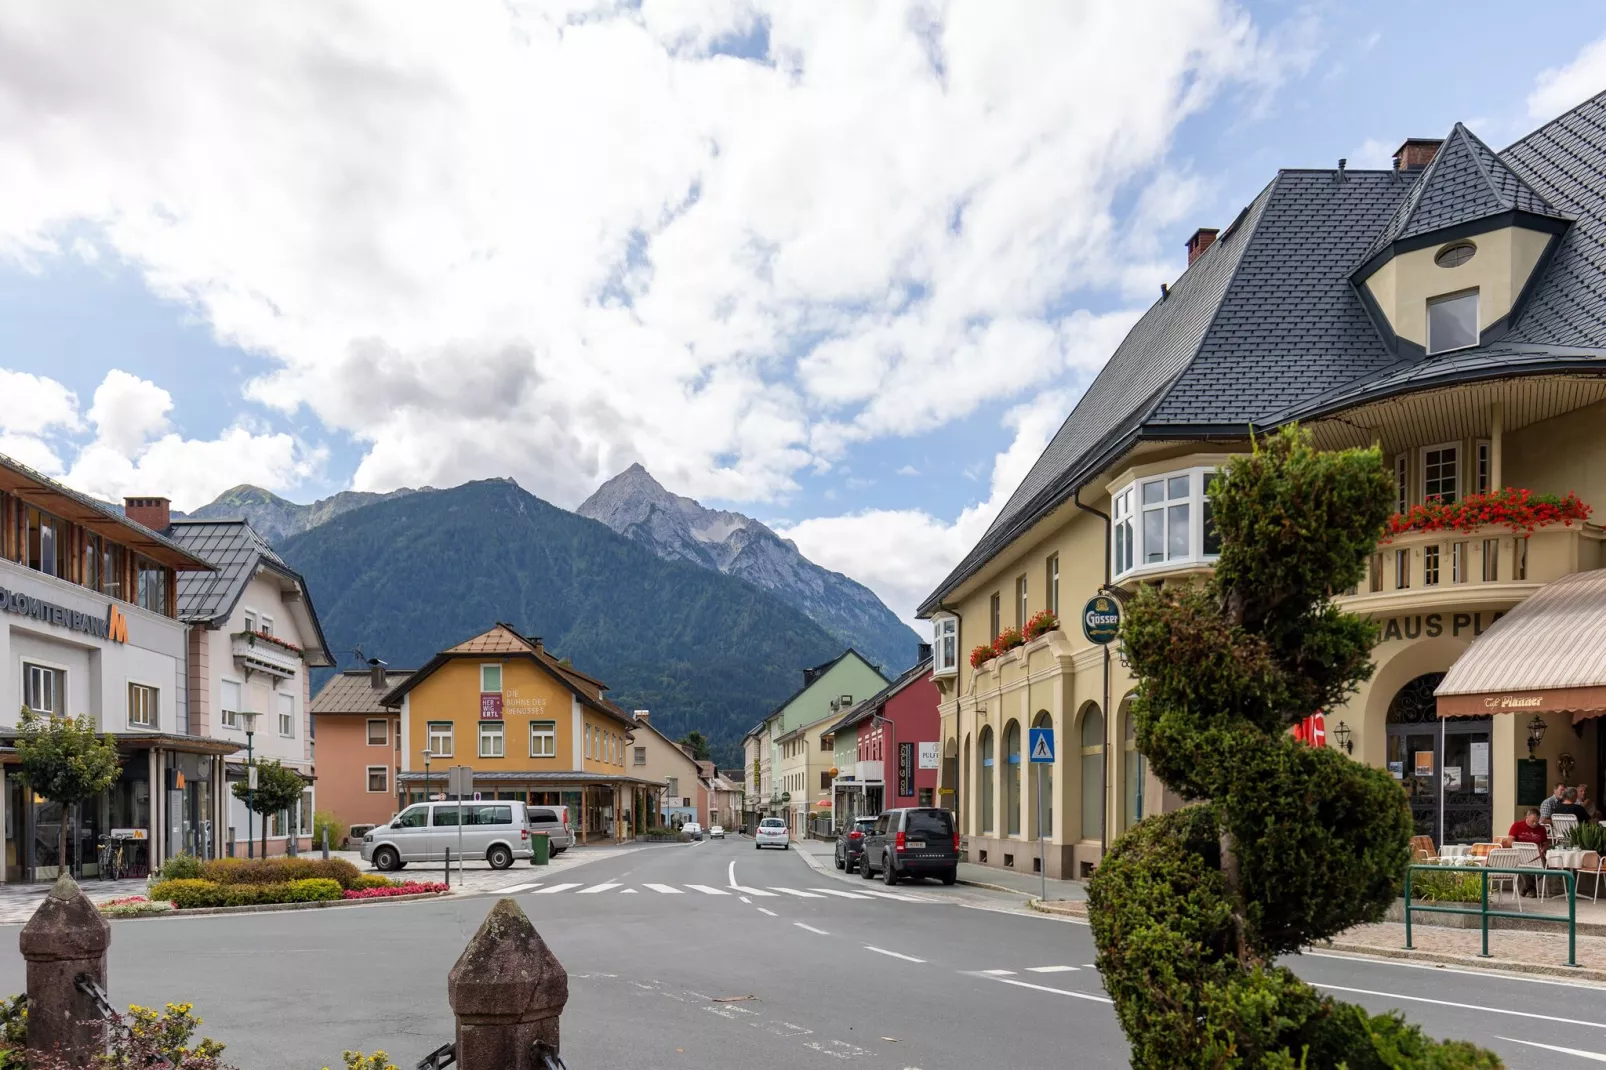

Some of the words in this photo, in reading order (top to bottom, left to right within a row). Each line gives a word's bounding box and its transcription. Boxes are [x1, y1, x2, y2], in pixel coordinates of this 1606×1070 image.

[1086, 611, 1118, 627] Gösser
[1453, 612, 1504, 637] PL
[532, 698, 547, 706] DES
[1501, 696, 1543, 708] Planner
